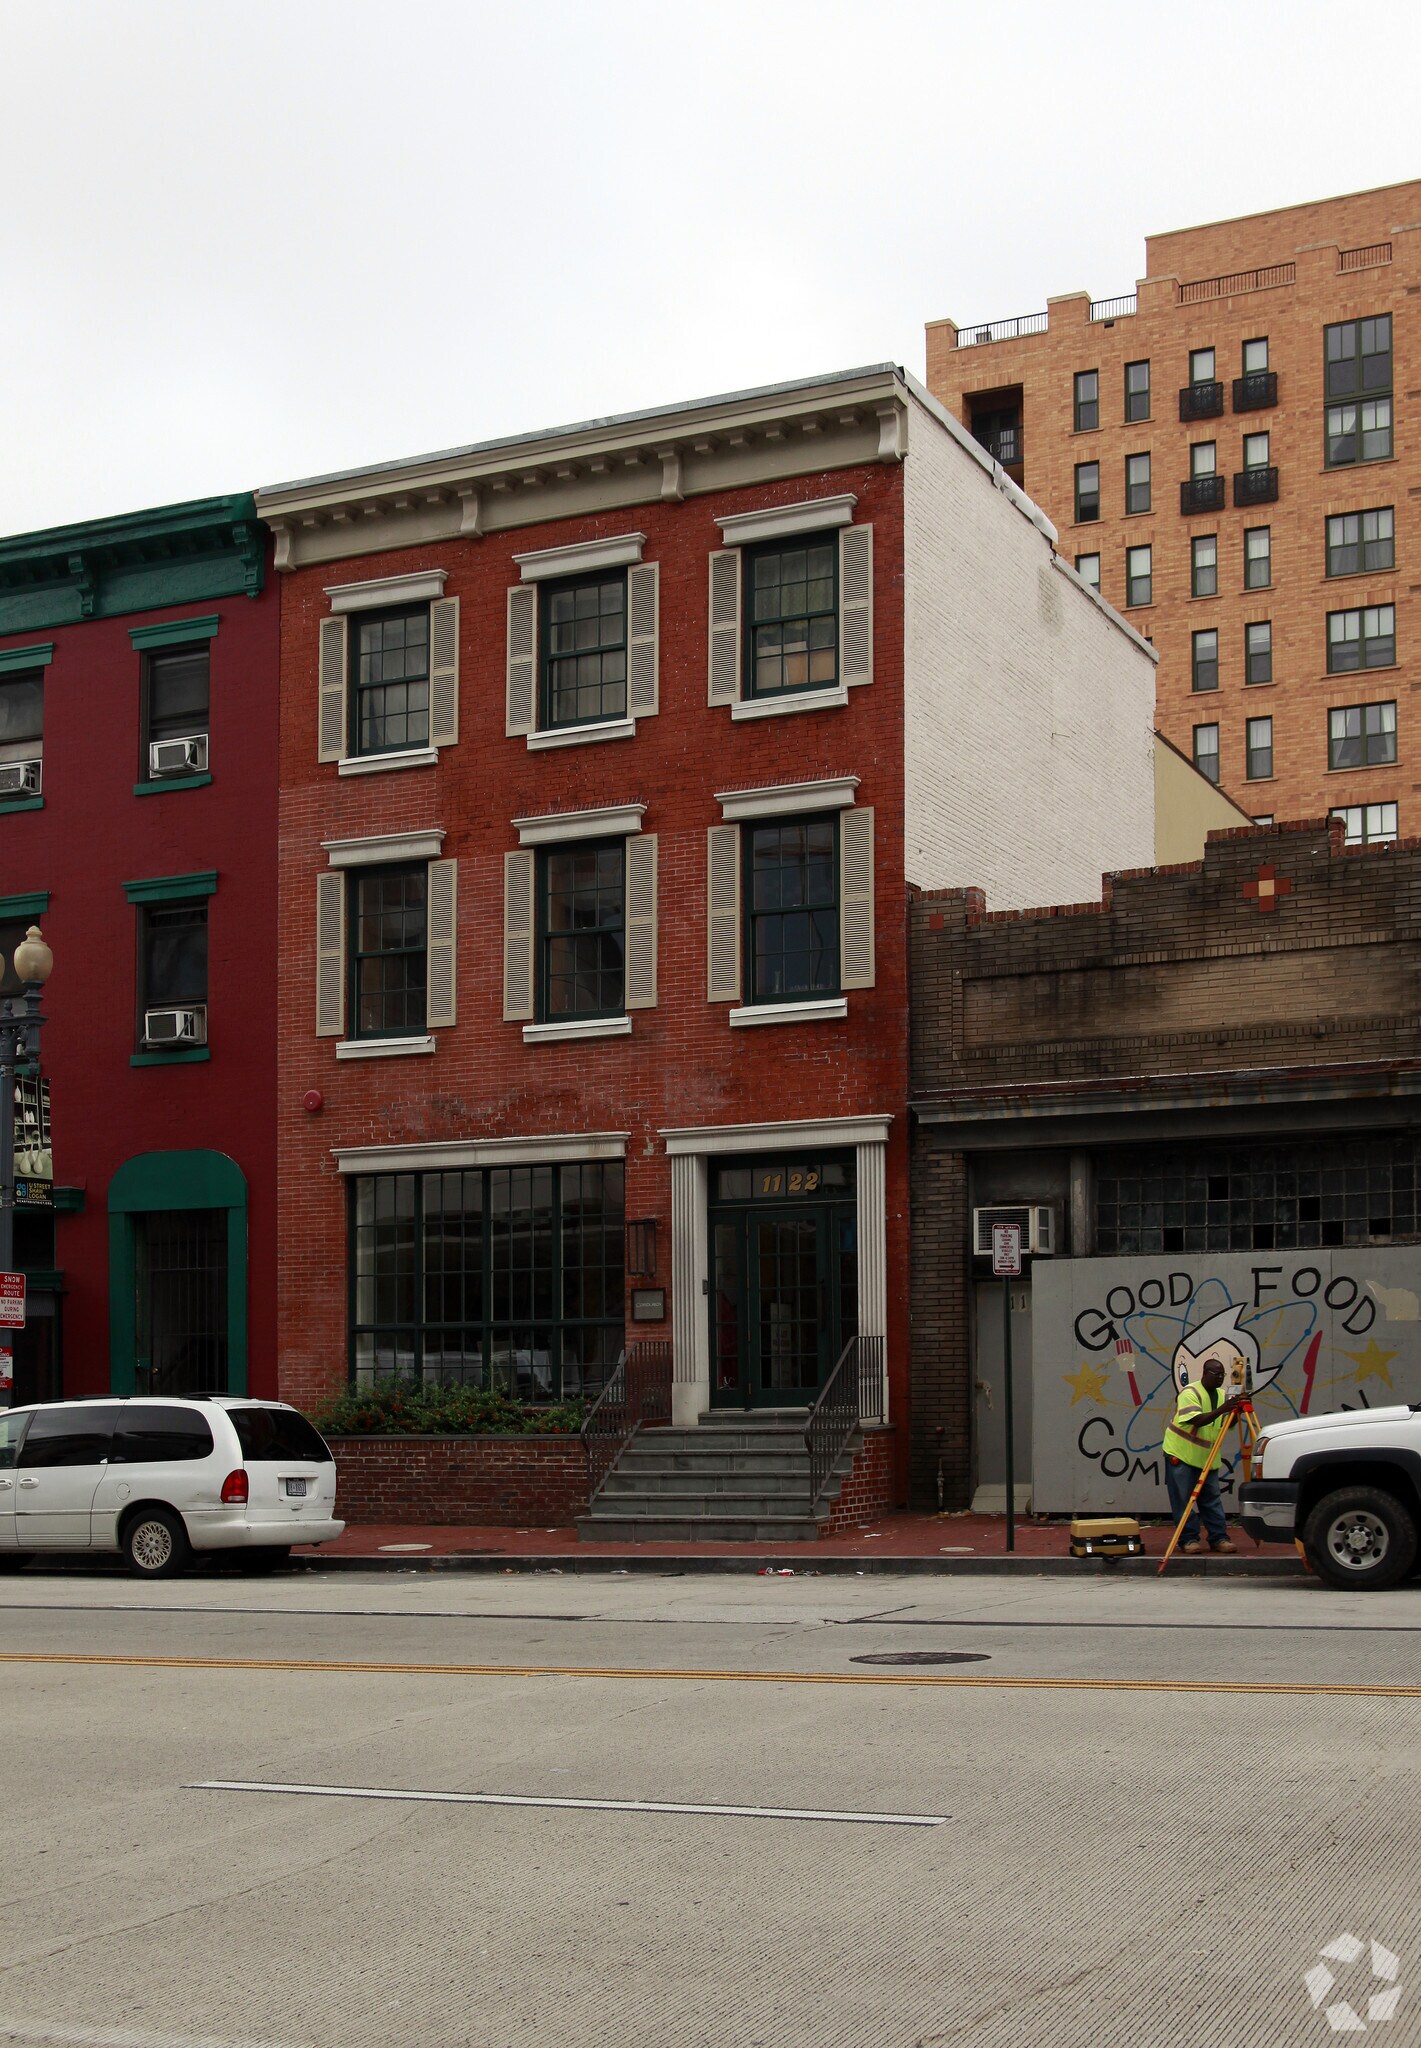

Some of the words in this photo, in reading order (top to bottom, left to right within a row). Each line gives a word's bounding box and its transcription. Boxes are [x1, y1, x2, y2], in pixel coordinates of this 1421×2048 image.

[762, 1171, 819, 1193] 1122
[4, 1275, 20, 1283] SNOW
[1074, 1272, 1194, 1351] GOOD
[1251, 1266, 1377, 1335] FOOD
